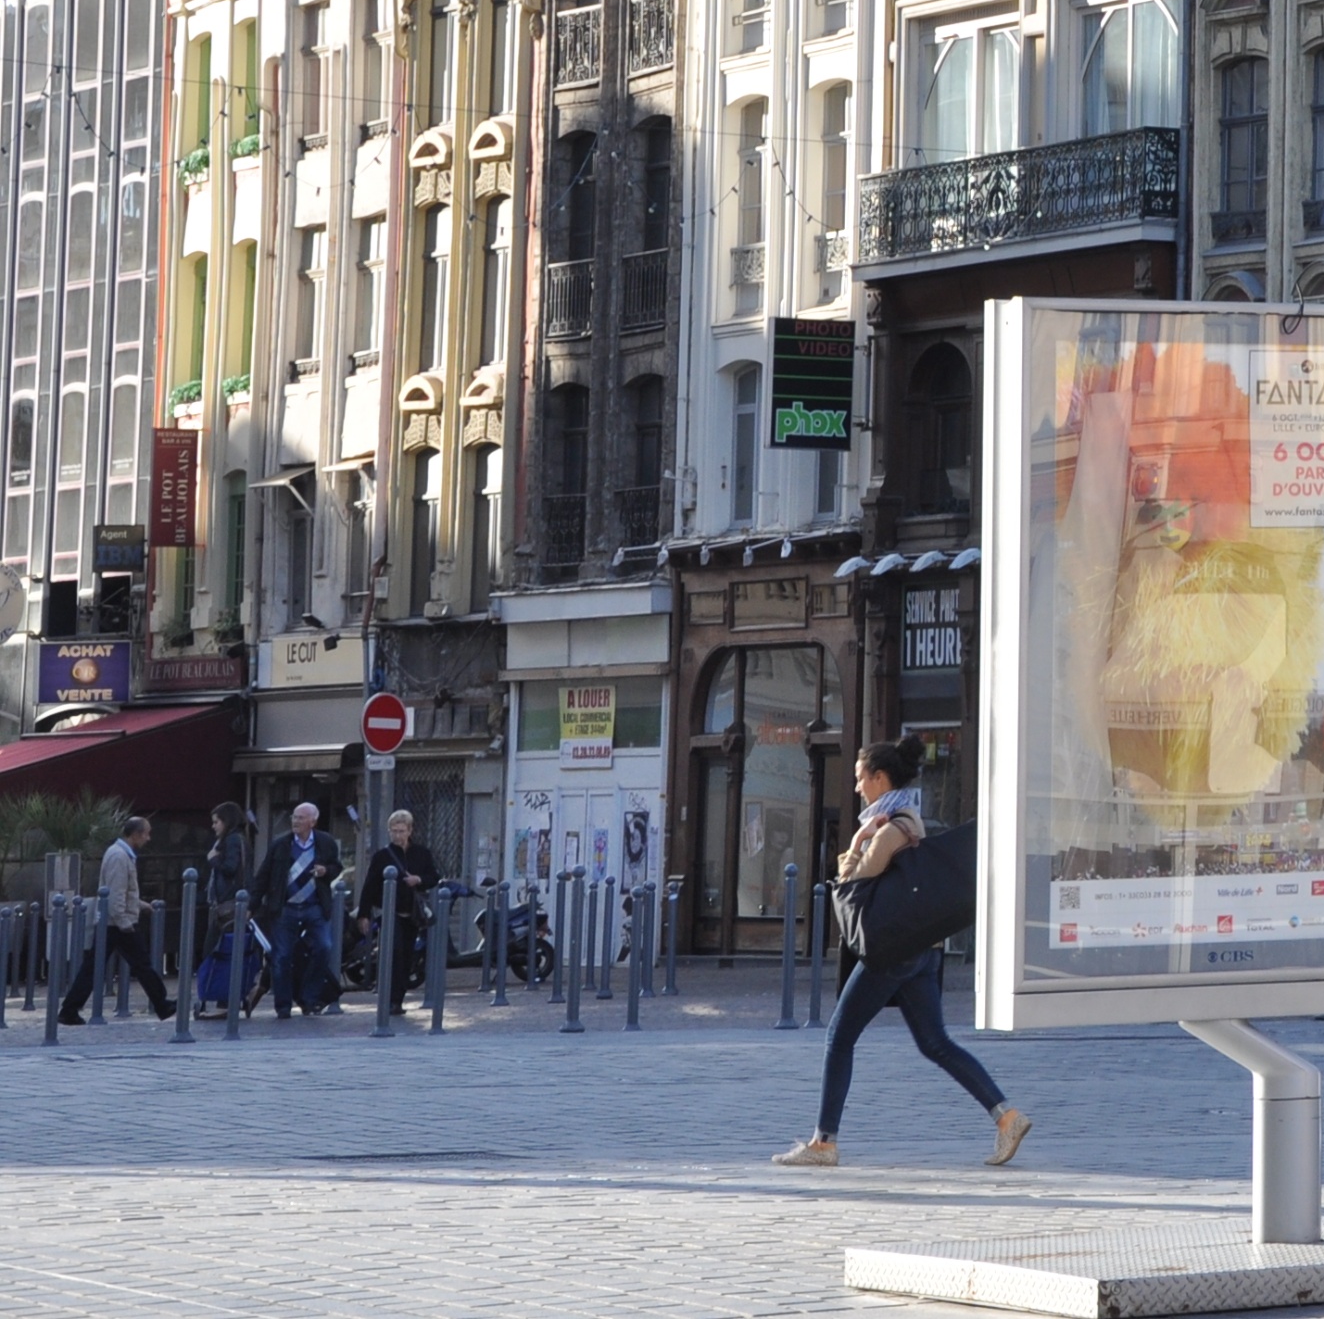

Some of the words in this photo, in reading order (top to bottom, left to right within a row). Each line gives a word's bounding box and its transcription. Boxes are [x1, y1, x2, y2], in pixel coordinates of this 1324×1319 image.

[795, 321, 851, 337] PHOTO
[798, 341, 851, 357] VIDEO
[775, 401, 848, 443] phox
[1273, 423, 1295, 432] LILLE
[1273, 442, 1288, 461] 6
[162, 470, 173, 499] POT
[175, 449, 189, 543] BEAUJOLAIS
[161, 504, 173, 522] LE
[100, 530, 127, 540] Agent
[96, 545, 143, 565] IBM
[906, 590, 936, 624] SERVICE
[57, 644, 114, 658] ACHAT
[287, 643, 297, 664] LE
[298, 641, 317, 663] CUT
[906, 630, 912, 667] 1
[151, 665, 162, 680] LE
[163, 664, 181, 679] POT
[182, 660, 235, 679] BEAUJOLAIS
[56, 688, 113, 702] VENTE
[567, 689, 575, 709] A
[578, 688, 611, 709] LOUER
[1217, 888, 1231, 897] Ville
[1232, 888, 1240, 897] de
[1240, 888, 1254, 897] Lille
[1277, 884, 1298, 894] Nord
[1220, 951, 1254, 963] CBS
